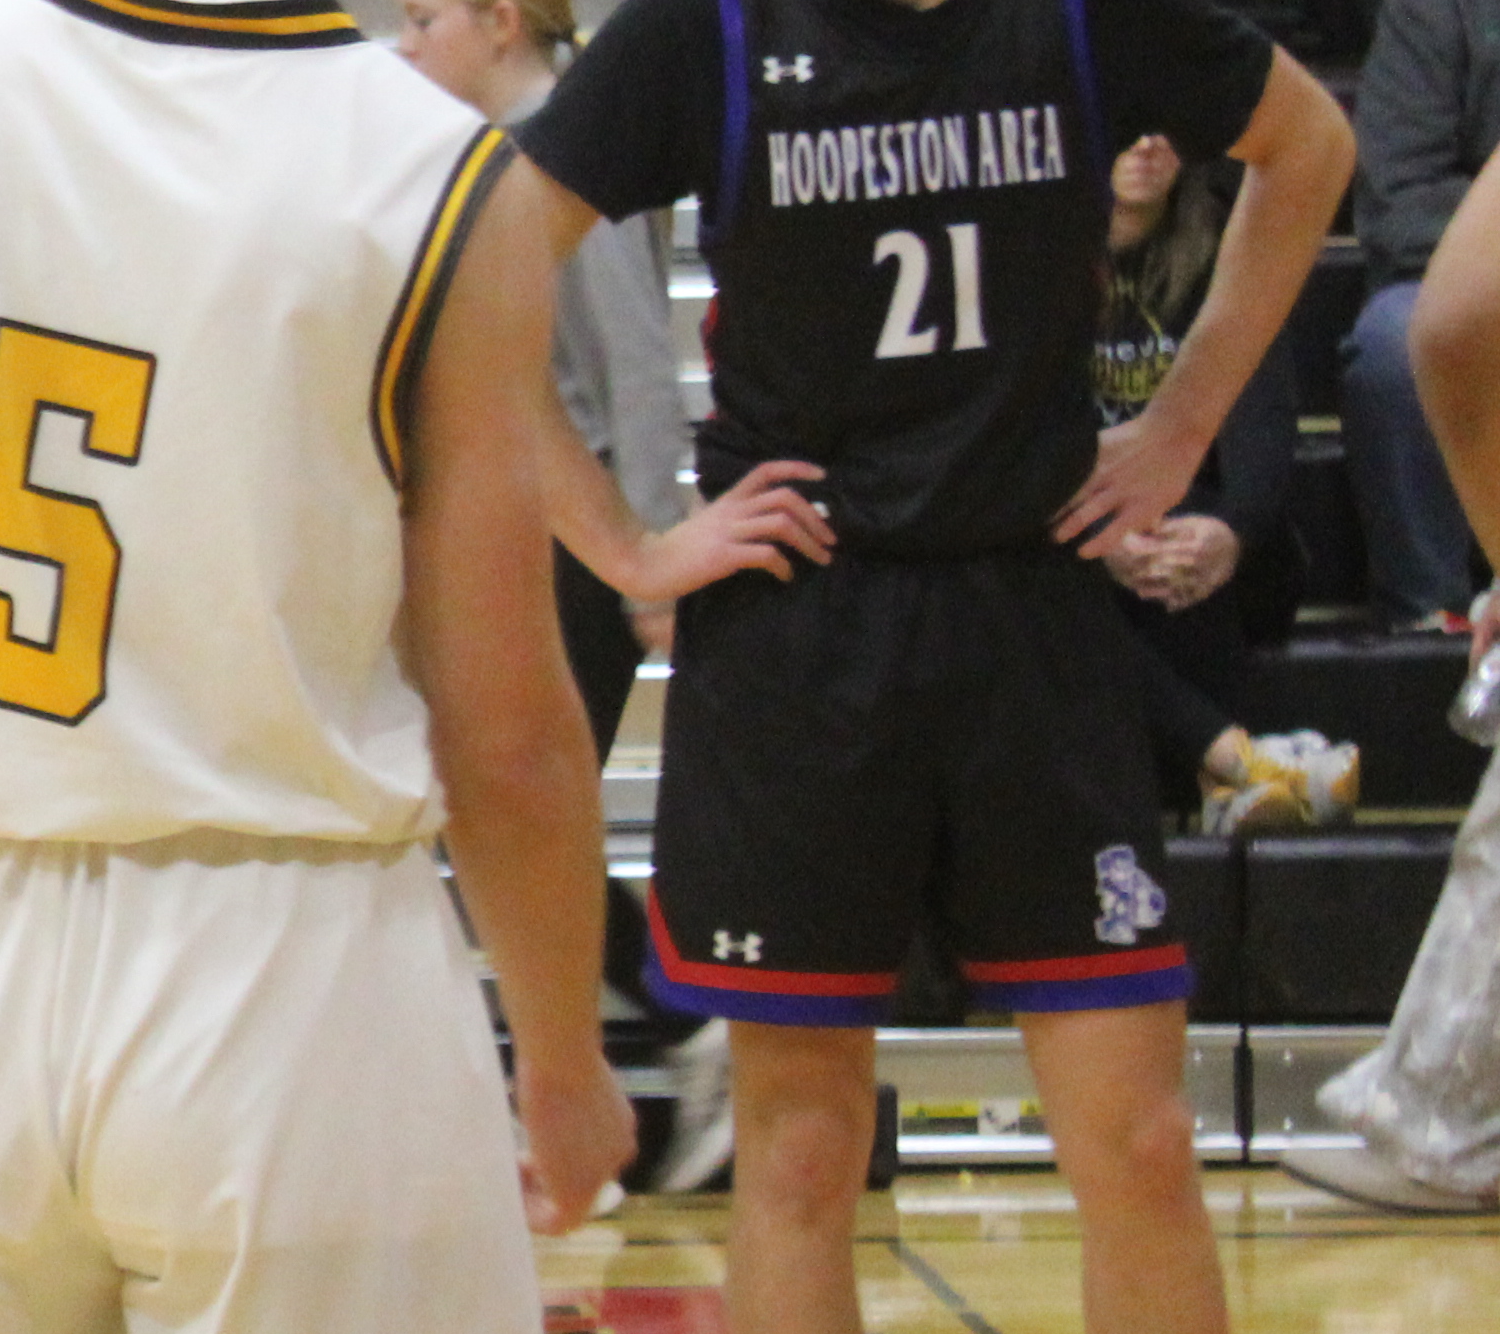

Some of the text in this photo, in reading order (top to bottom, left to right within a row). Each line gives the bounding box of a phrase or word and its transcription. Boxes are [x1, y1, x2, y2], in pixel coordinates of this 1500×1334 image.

[768, 104, 1066, 208] HOOPESTON AREA
[873, 222, 988, 360] 21
